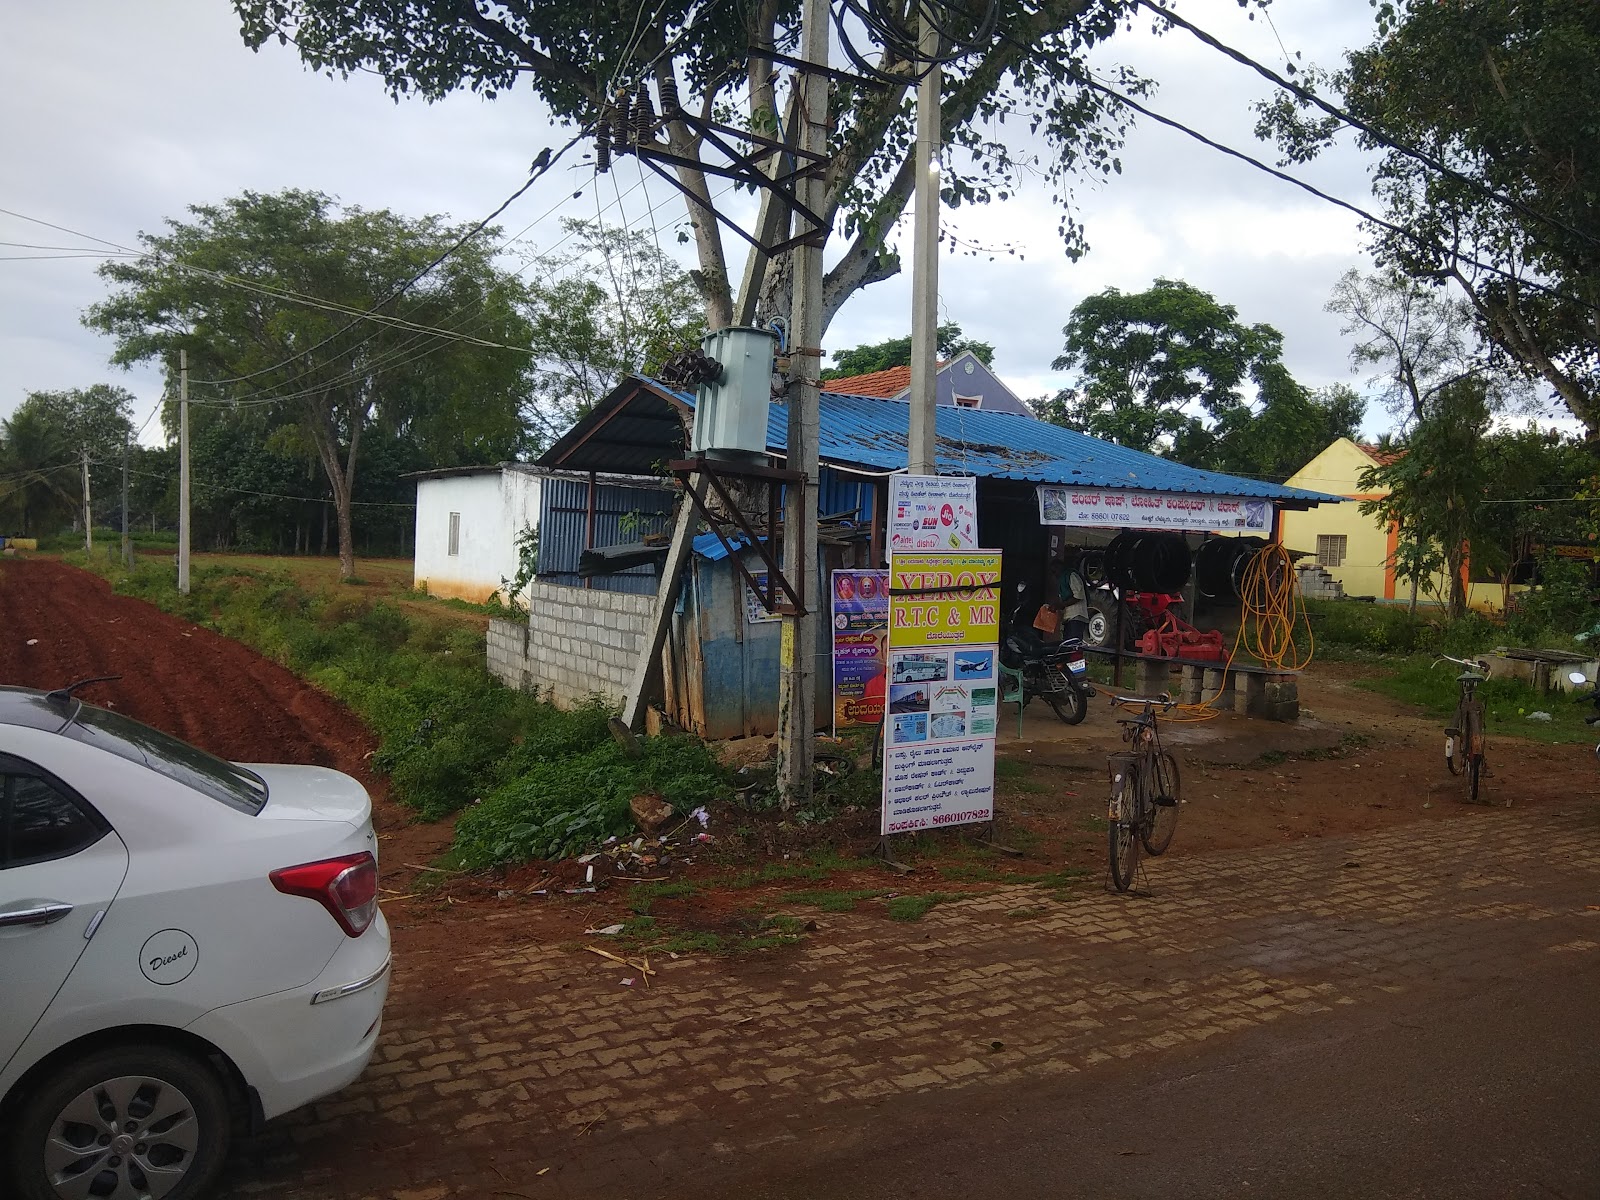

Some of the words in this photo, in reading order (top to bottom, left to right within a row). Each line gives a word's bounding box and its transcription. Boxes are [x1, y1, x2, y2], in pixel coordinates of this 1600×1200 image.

[1071, 492, 1100, 506] ಪಂಚರ್
[922, 517, 939, 526] SUN
[942, 509, 953, 520] Jio
[1110, 513, 1130, 521] 07822
[900, 535, 914, 544] airtel
[895, 572, 998, 602] XEROX
[894, 606, 939, 628] R.T.C
[947, 606, 961, 626] &
[969, 605, 996, 625] MR
[932, 808, 990, 825] 8660107822
[149, 945, 188, 971] Diesel
